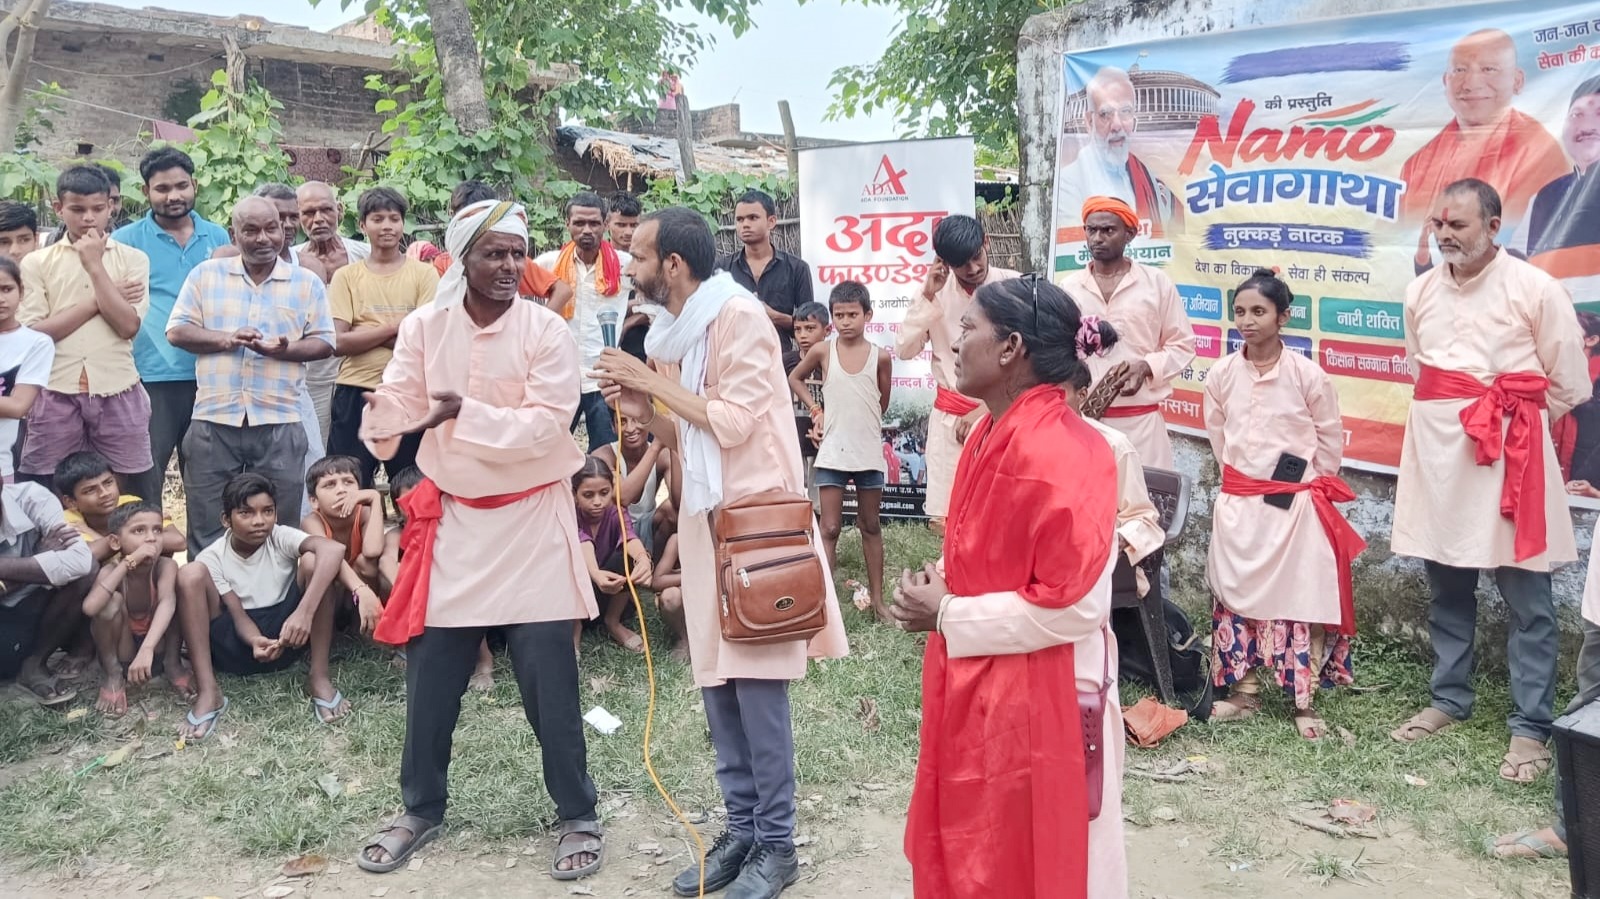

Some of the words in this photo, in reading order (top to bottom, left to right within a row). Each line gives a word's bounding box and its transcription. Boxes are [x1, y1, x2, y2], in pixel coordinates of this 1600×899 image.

[1534, 21, 1590, 42] जन-जन
[1537, 52, 1564, 69] सेवा
[1567, 44, 1586, 63] की
[1265, 95, 1282, 110] की
[1287, 92, 1333, 111] प्रस्तुति
[1177, 97, 1396, 176] Namo
[1186, 164, 1403, 219] सेवागाथा
[1223, 227, 1282, 247] नुक्कड़
[1288, 228, 1344, 244] नाटक
[1195, 258, 1210, 273] देश
[1213, 263, 1227, 275] का
[1288, 264, 1309, 280] सेवा
[1314, 266, 1326, 281] ही
[1332, 267, 1370, 283] संकल्प
[1189, 293, 1219, 313] अभियान
[1336, 308, 1363, 327] नारी
[1366, 310, 1400, 330] शक्ति
[1326, 347, 1355, 369] किसान
[1357, 356, 1390, 373] सम्मान
